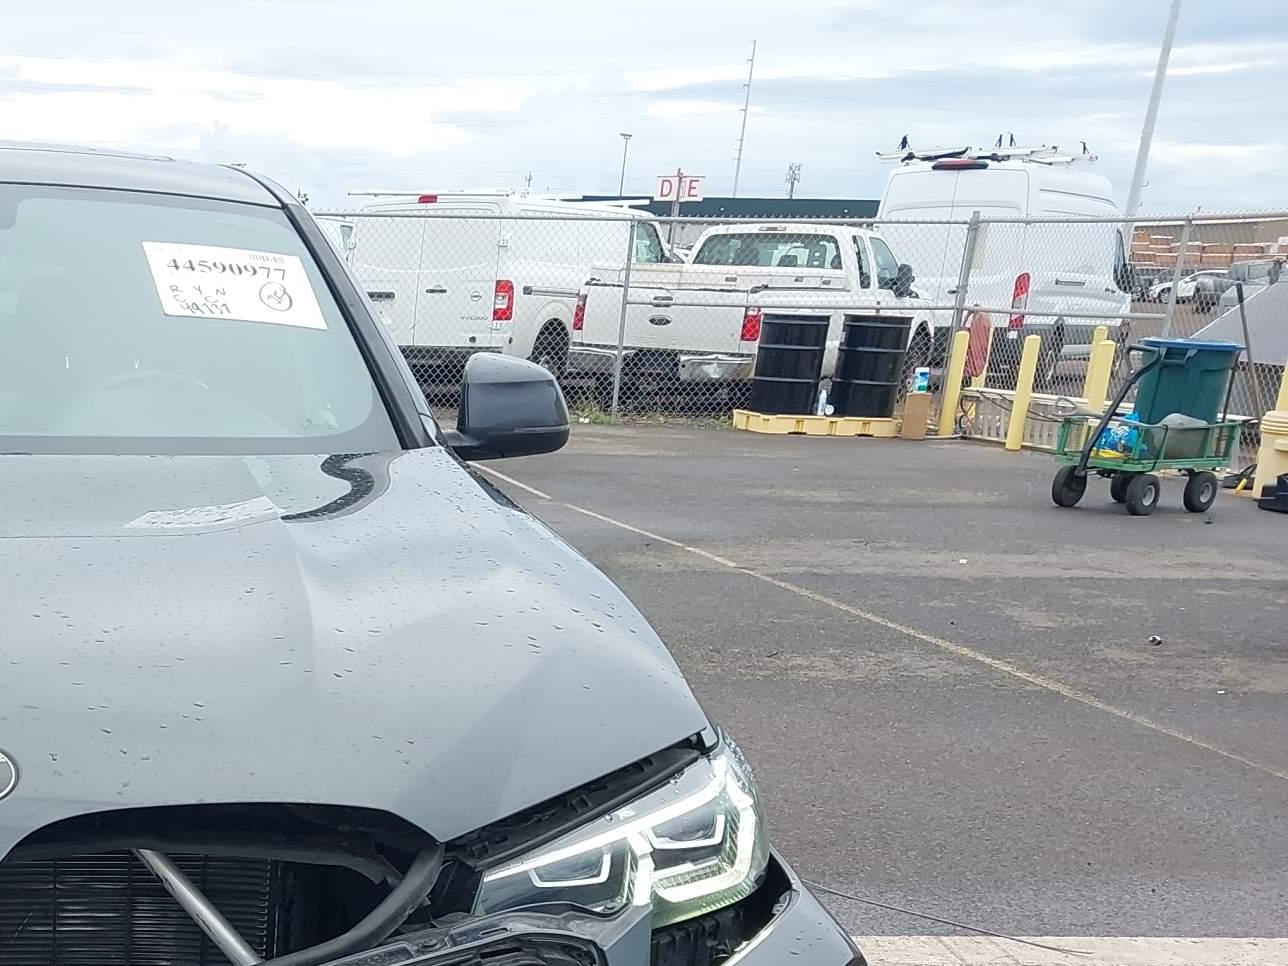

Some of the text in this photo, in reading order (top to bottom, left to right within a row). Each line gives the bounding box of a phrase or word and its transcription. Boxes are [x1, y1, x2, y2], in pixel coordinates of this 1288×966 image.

[660, 179, 673, 198] D
[687, 179, 700, 198] E
[166, 257, 286, 281] 44590977
